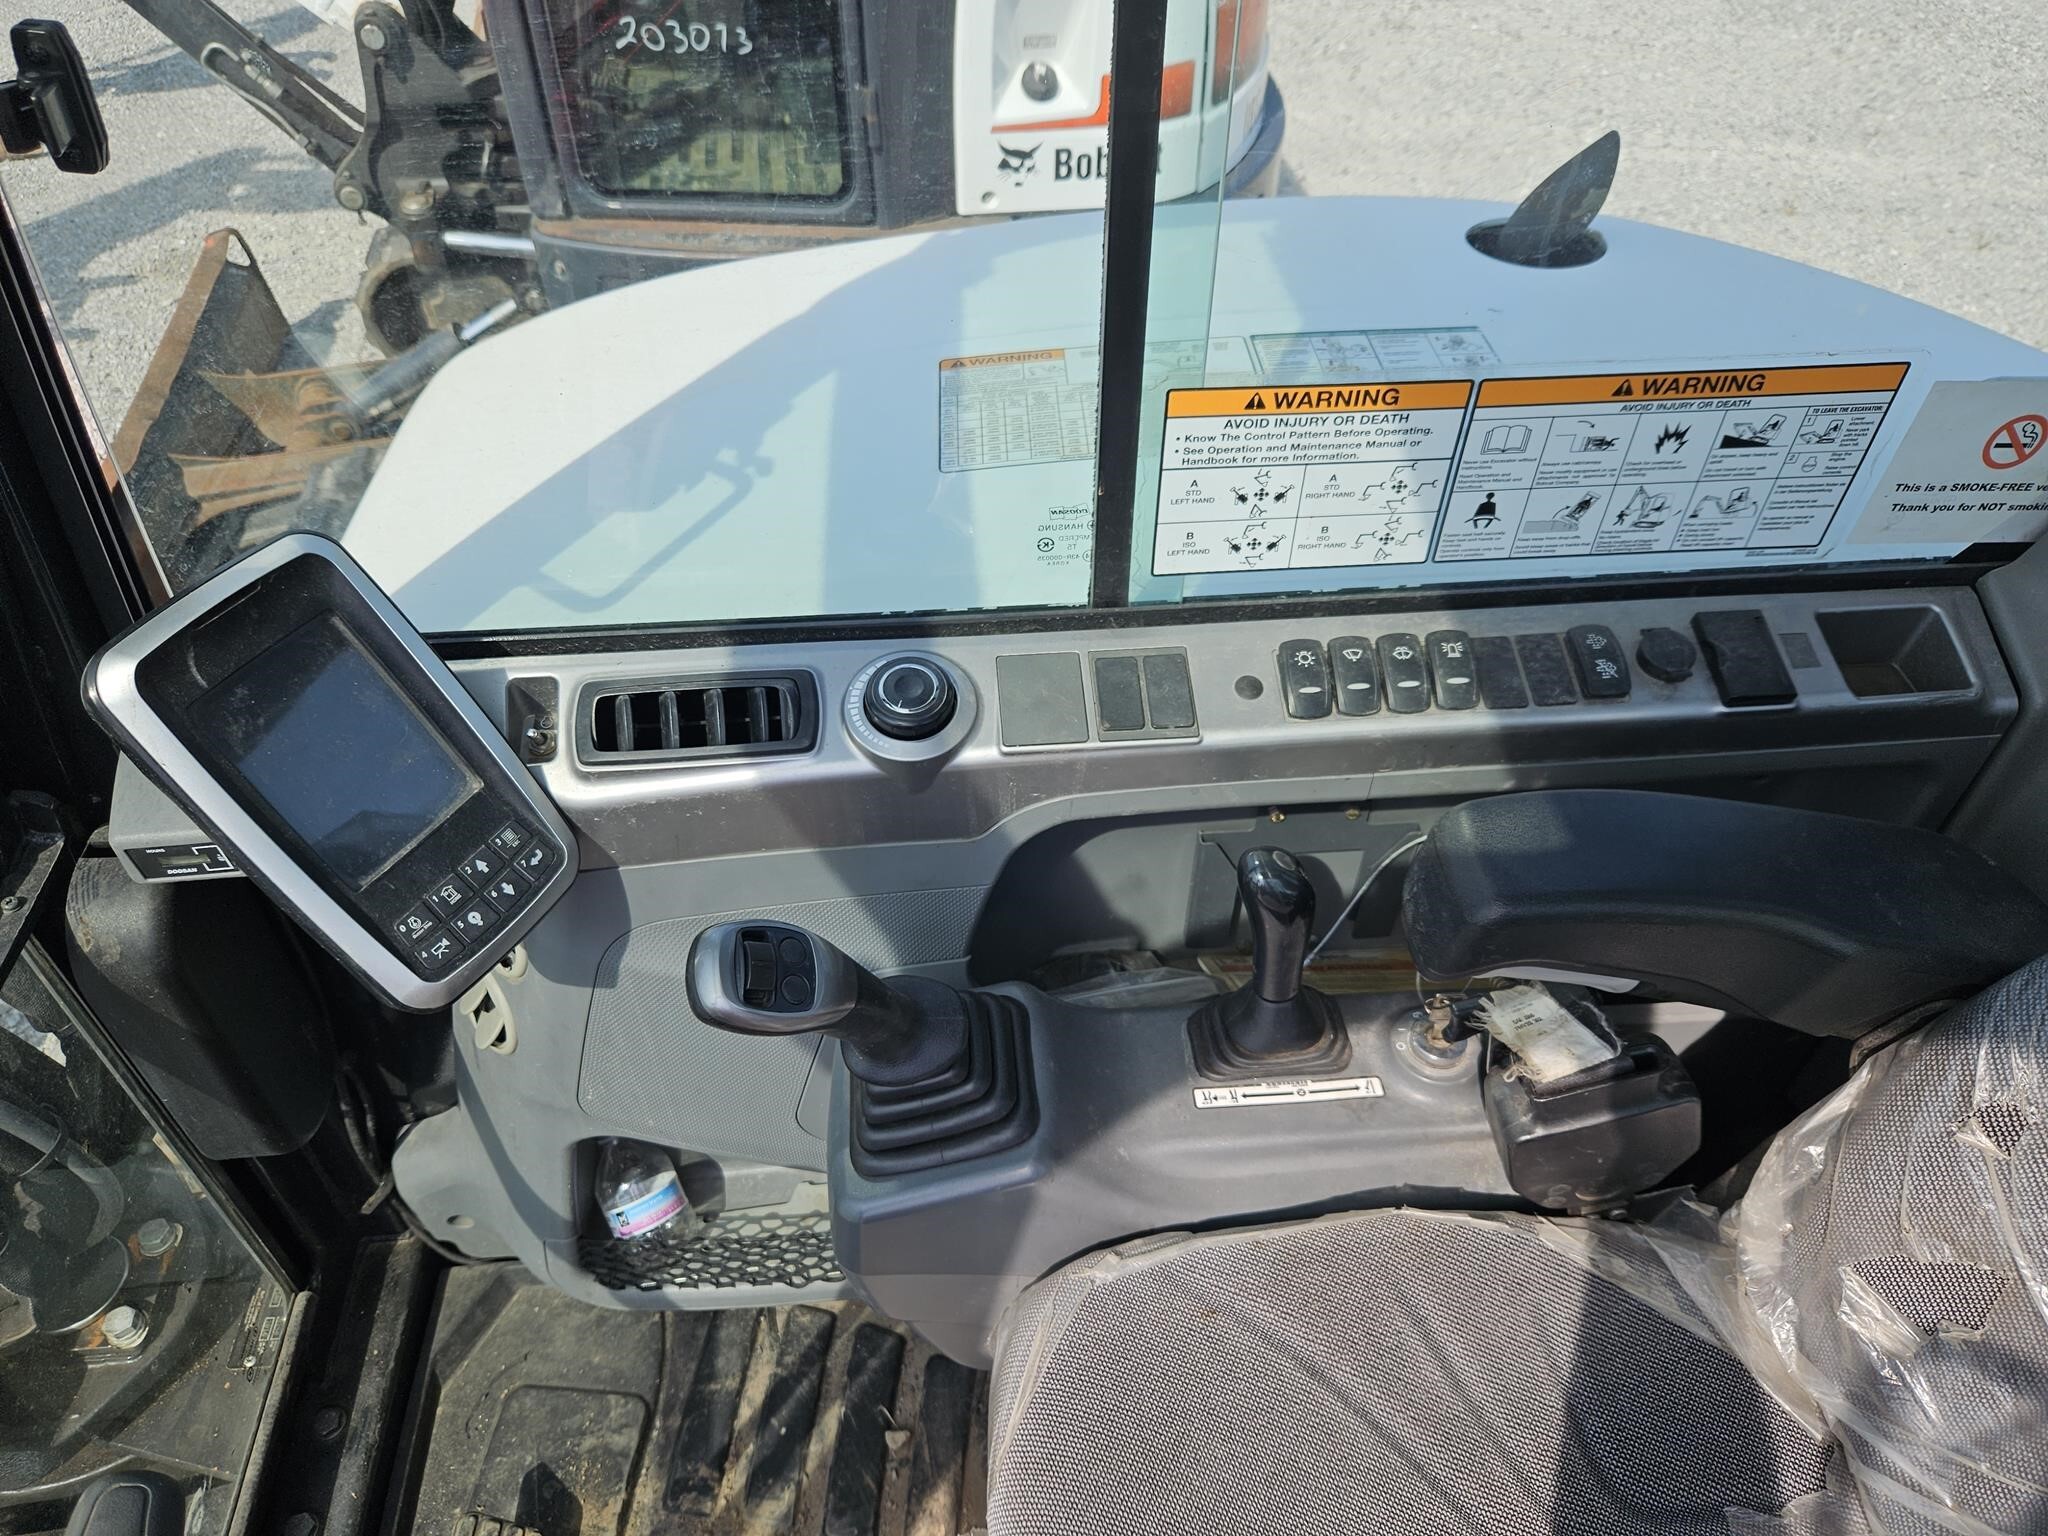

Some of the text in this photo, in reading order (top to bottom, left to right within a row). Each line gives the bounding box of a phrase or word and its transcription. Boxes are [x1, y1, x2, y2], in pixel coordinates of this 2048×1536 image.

[615, 15, 753, 56] 203013
[968, 352, 1053, 366] WARNING
[1643, 374, 1766, 396] WARNING
[1273, 388, 1400, 410] WARNING
[1620, 399, 1752, 413] AVOID INJURY OR DEATH
[1223, 413, 1410, 430] AVOID INJURY OR DEATH
[1184, 427, 1433, 443] Know The Control Pattern Before Operating.
[1183, 440, 1422, 456] See Operation and Maintenance Manual or
[1182, 452, 1360, 467] Handbook for more Information.
[1329, 473, 1338, 483] A
[1190, 479, 1199, 488] A
[1895, 482, 1920, 492] This
[1924, 482, 1935, 492] is
[1938, 484, 1947, 492] a
[1950, 482, 2034, 492] SMOKE-FREE
[1185, 489, 1202, 497] STD
[1305, 491, 1356, 500] RIGHT HAND
[1191, 497, 1216, 505] HAND
[1891, 503, 1927, 512] Thank
[1930, 504, 1955, 513] you
[1957, 502, 1975, 513] for
[1978, 502, 2006, 511] NOT
[1321, 526, 1329, 534] B
[1186, 532, 1194, 540] B
[1166, 549, 1186, 557] LEFT
[495, 838, 502, 846] 3
[520, 859, 527, 868] 7
[464, 866, 473, 875] 2
[490, 889, 498, 898] 6
[432, 895, 439, 903] 1
[457, 920, 465, 930] 5
[421, 951, 428, 959] 4
